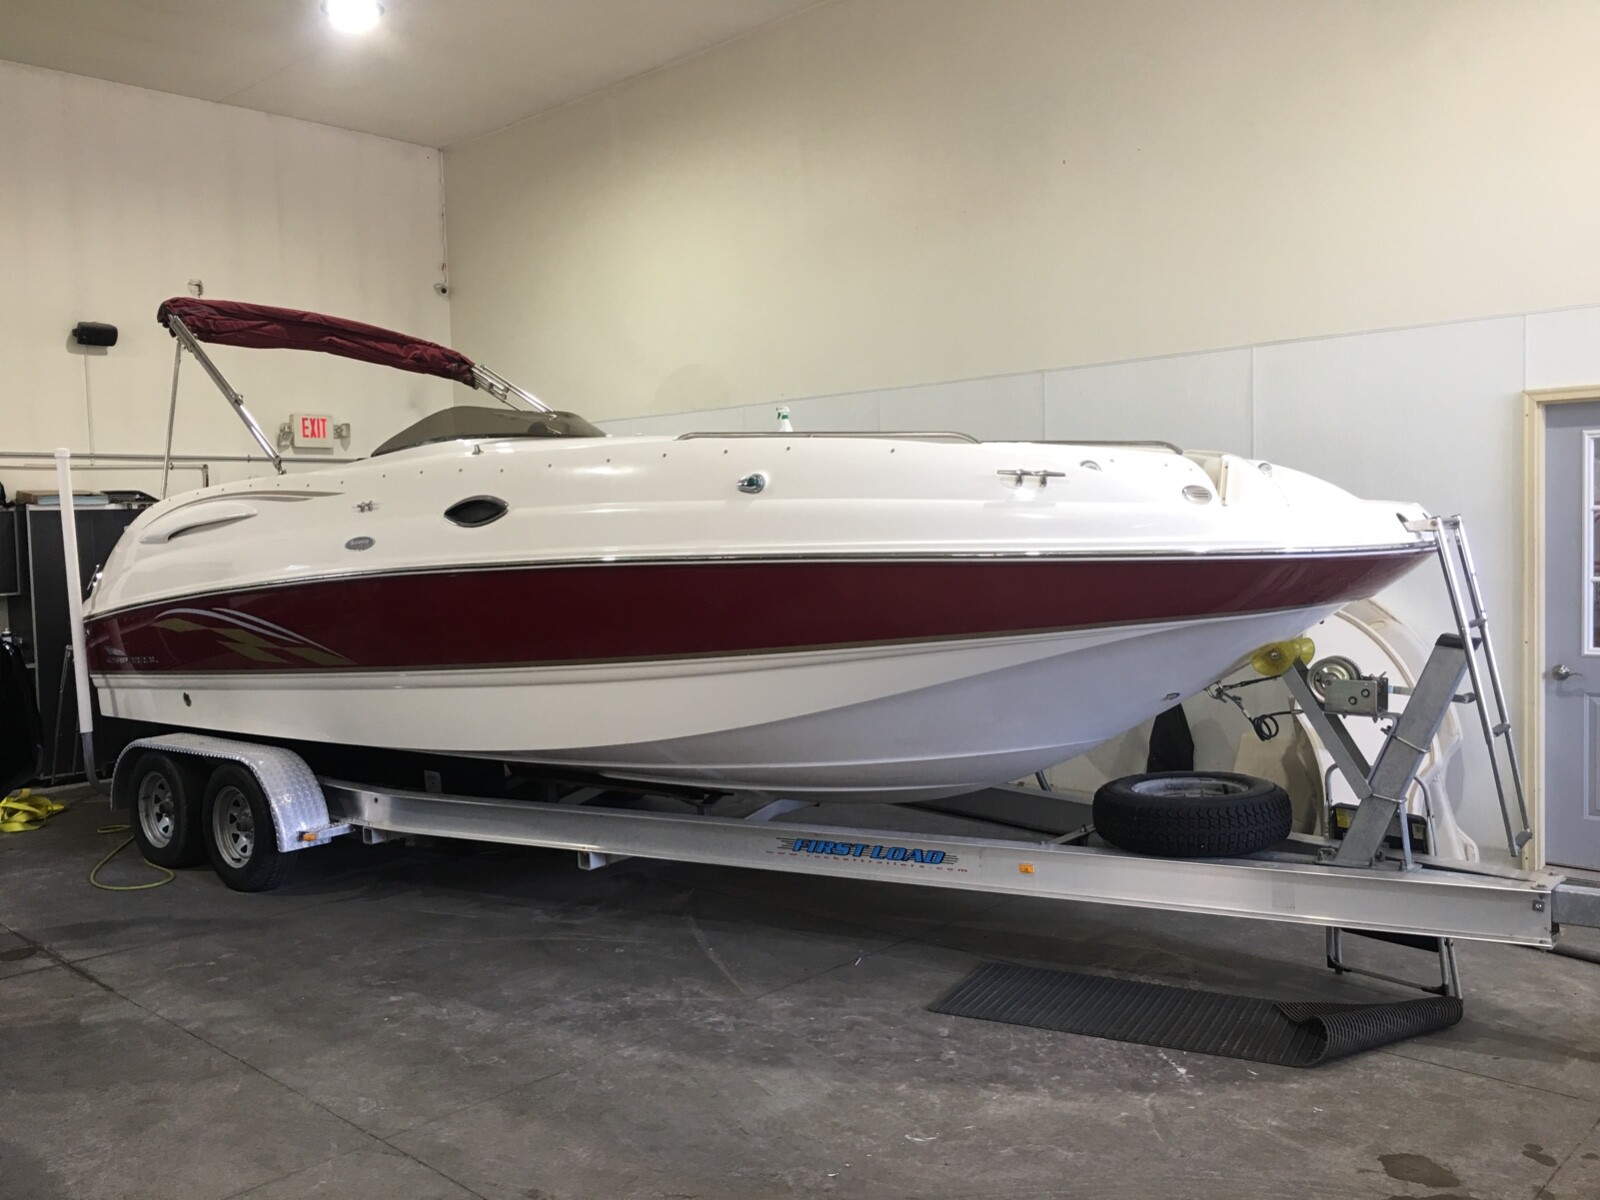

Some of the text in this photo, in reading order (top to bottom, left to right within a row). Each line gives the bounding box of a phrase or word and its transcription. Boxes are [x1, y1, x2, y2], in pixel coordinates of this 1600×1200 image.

[302, 417, 327, 438] EXIT
[792, 838, 946, 864] FIRST LOAD
